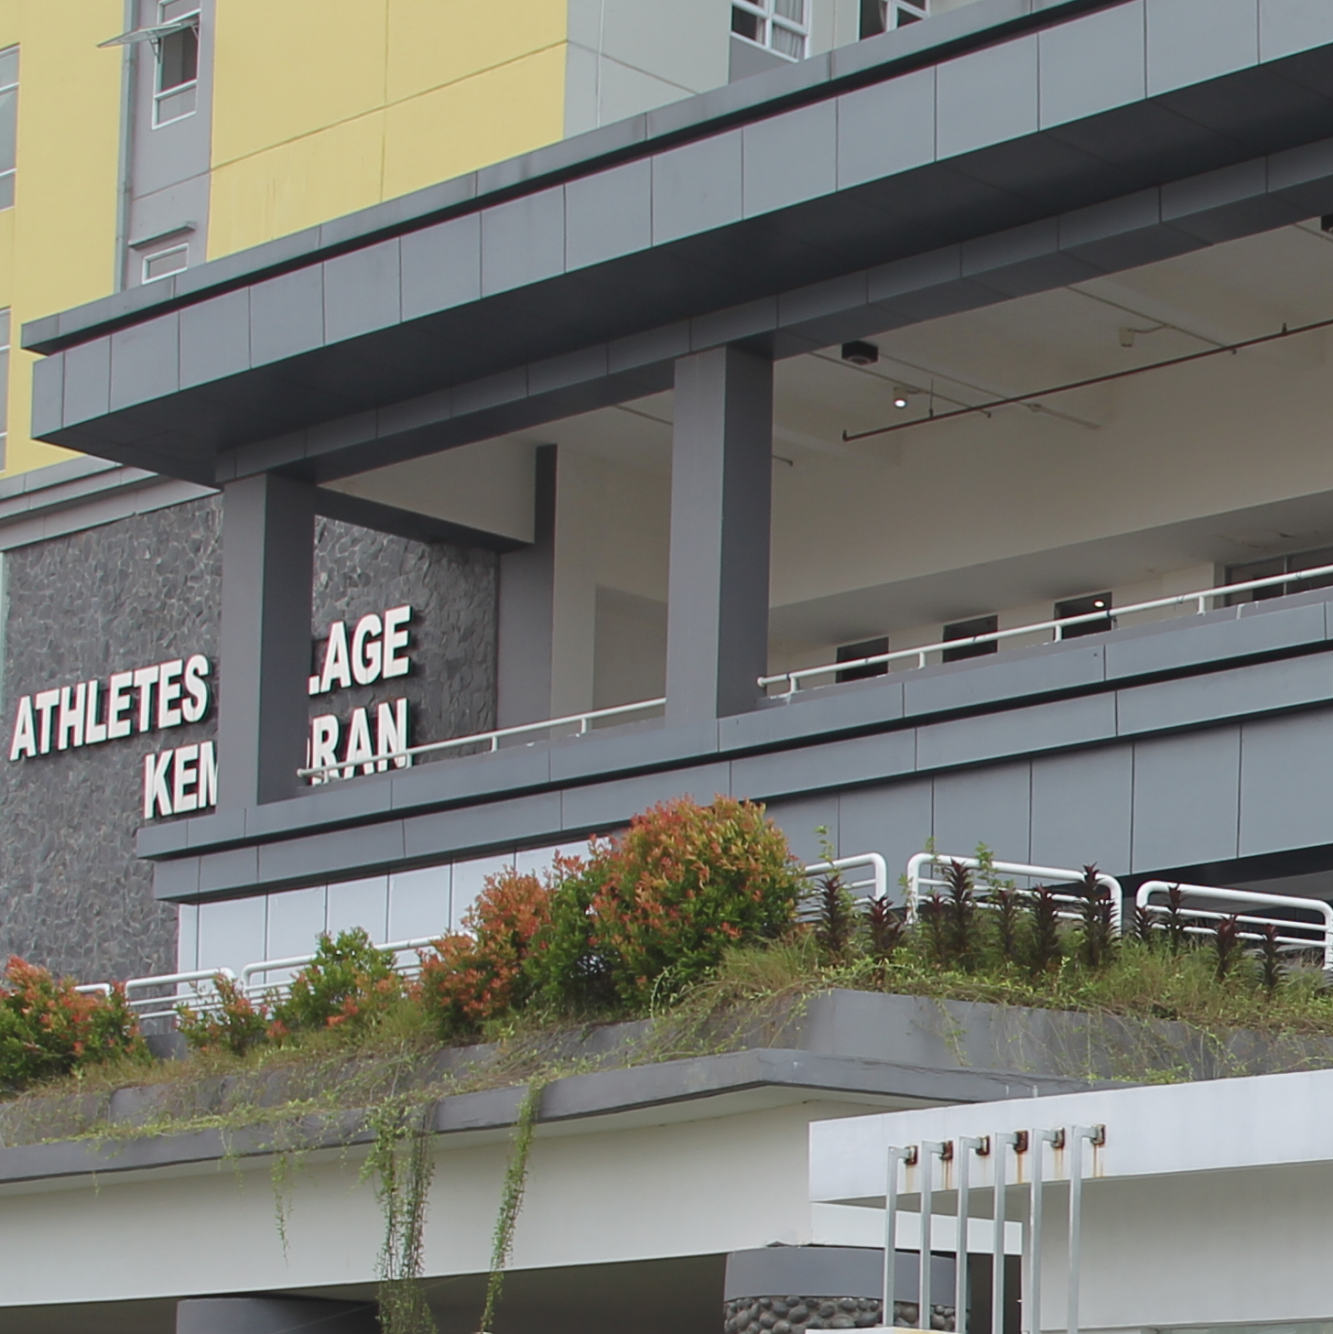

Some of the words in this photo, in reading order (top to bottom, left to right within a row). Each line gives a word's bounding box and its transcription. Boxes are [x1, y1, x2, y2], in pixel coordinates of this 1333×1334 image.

[9, 654, 210, 762] ATHLETES
[308, 604, 412, 696] AGE
[307, 697, 412, 786] RAN
